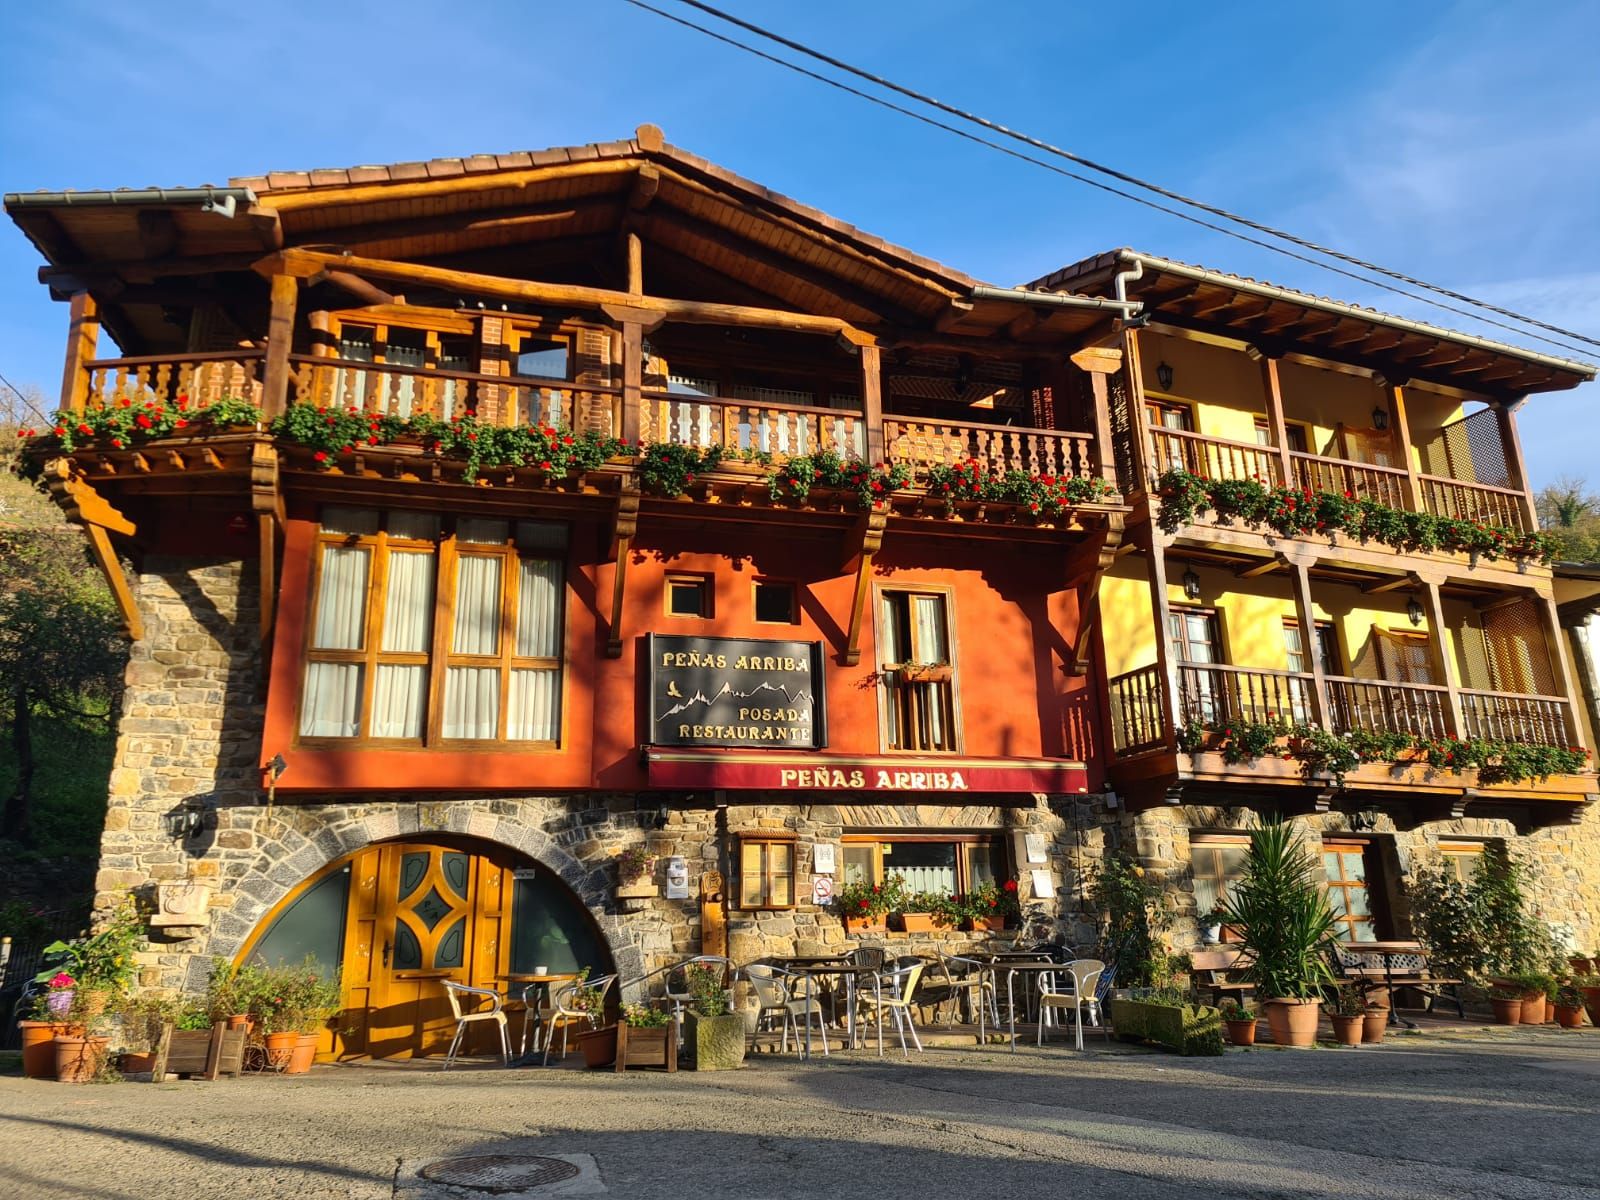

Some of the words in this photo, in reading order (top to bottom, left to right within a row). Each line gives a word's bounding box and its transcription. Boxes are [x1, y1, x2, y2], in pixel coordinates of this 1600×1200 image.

[662, 650, 727, 669] PEÑAS
[734, 655, 809, 672] ARRIBA
[739, 707, 810, 722] POSADA
[679, 724, 810, 740] RESTAURANTE
[781, 766, 866, 788] PEÑAS
[875, 770, 969, 790] ARRIBA
